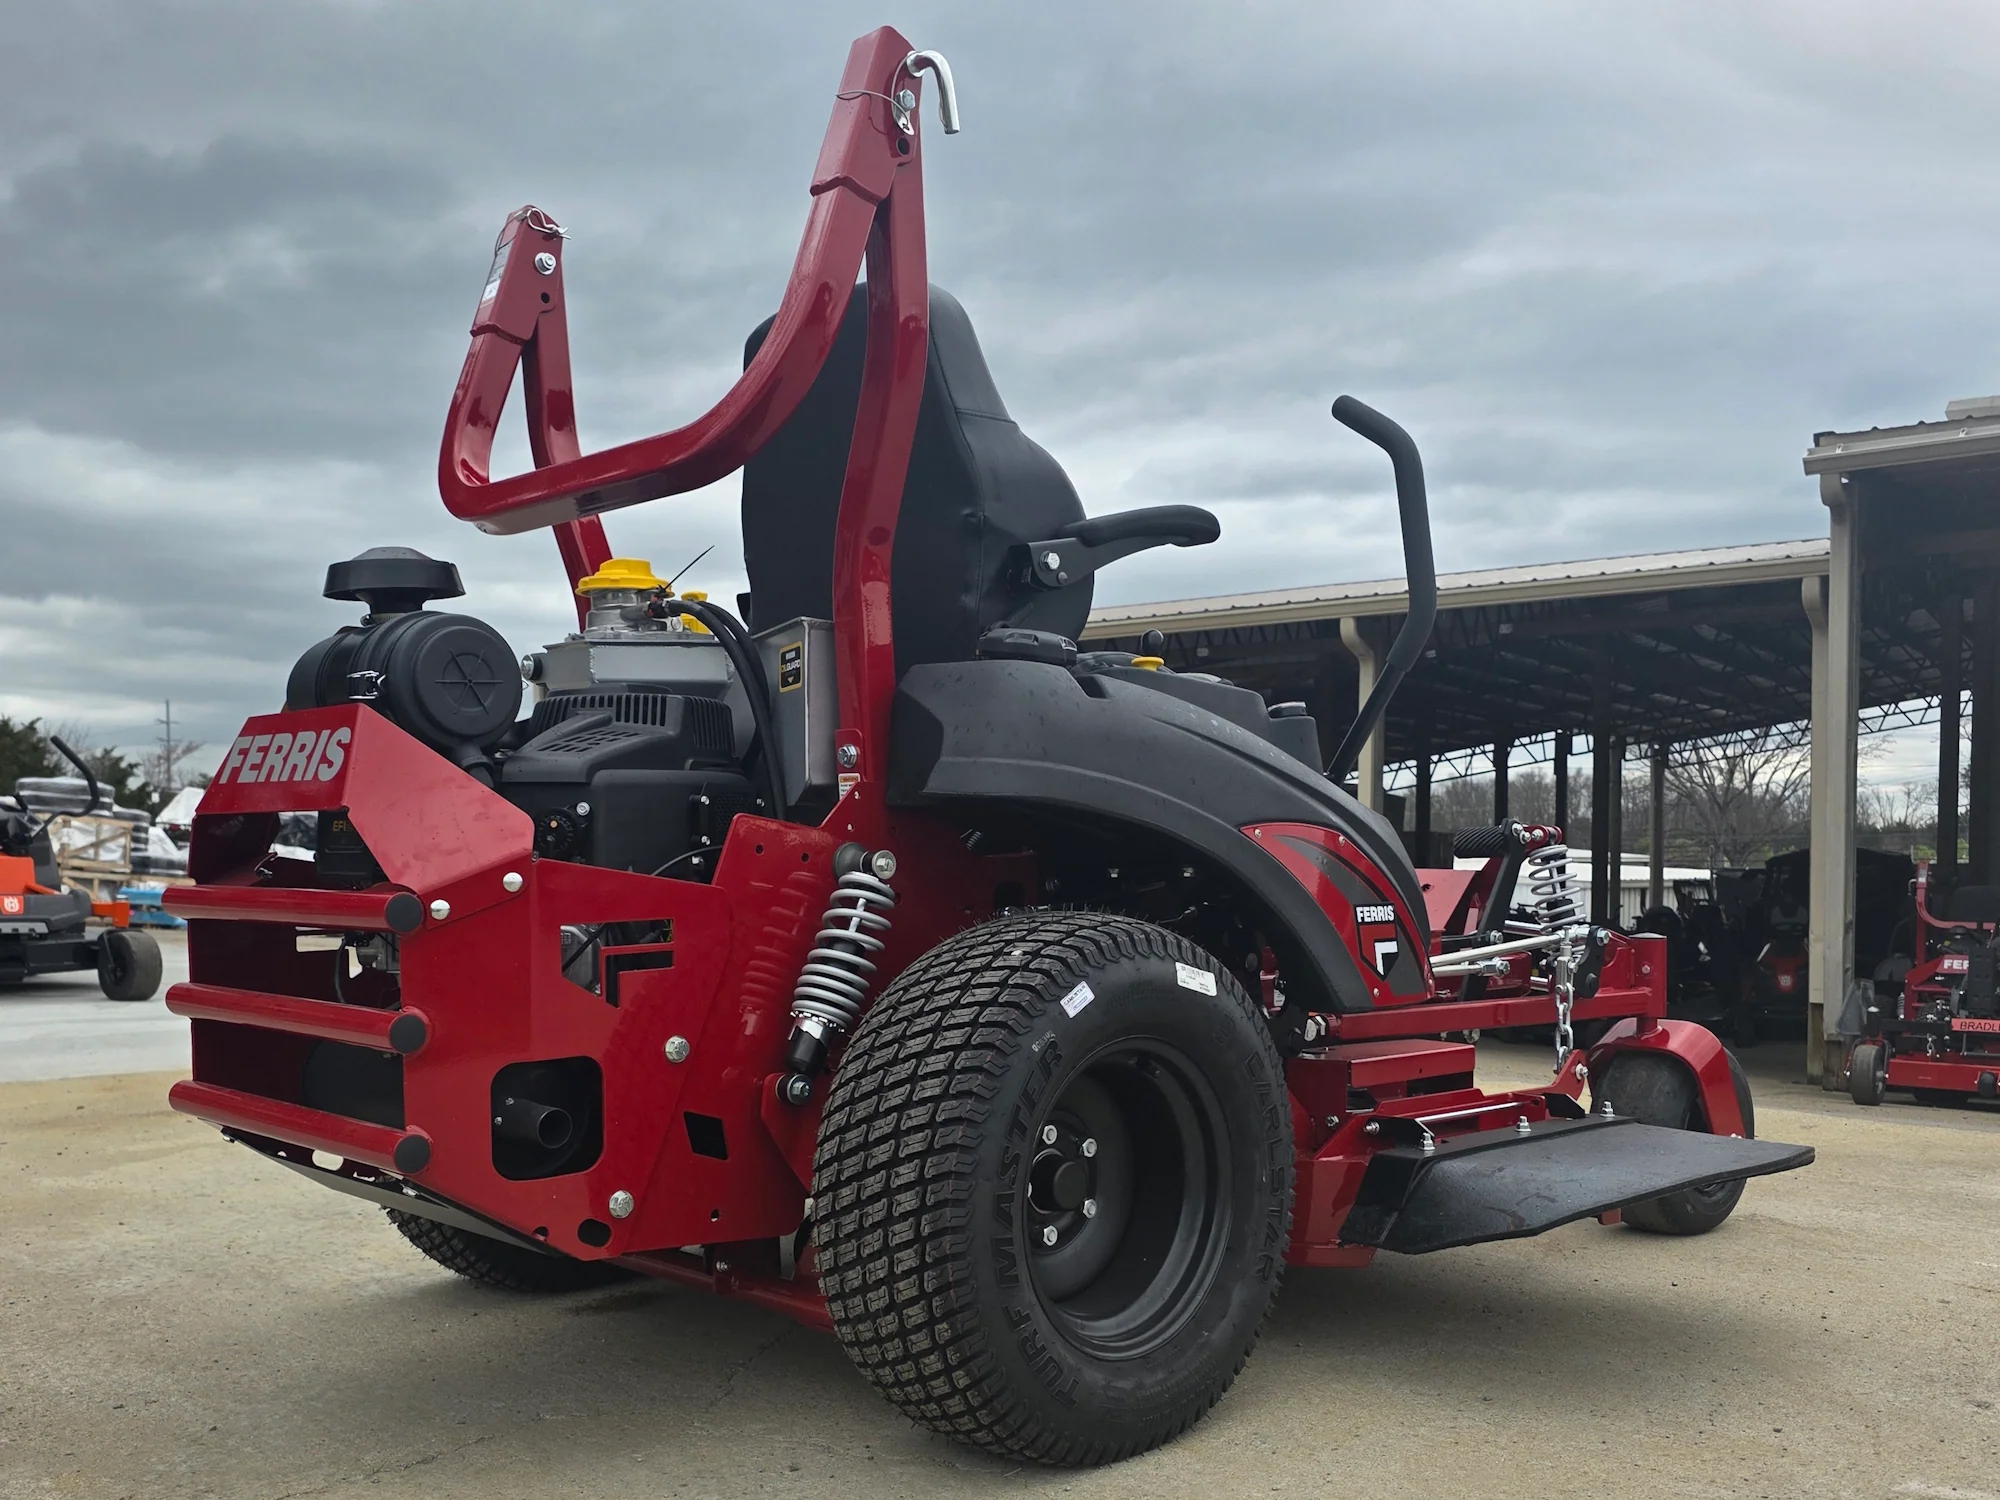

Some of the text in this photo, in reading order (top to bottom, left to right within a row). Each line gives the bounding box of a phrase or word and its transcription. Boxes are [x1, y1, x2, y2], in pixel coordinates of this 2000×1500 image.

[219, 727, 351, 784] FERRIS
[1355, 904, 1395, 923] FERRIS
[993, 1039, 1080, 1408] TURF MASTER
[1245, 1050, 1288, 1285] CARLSTAR
